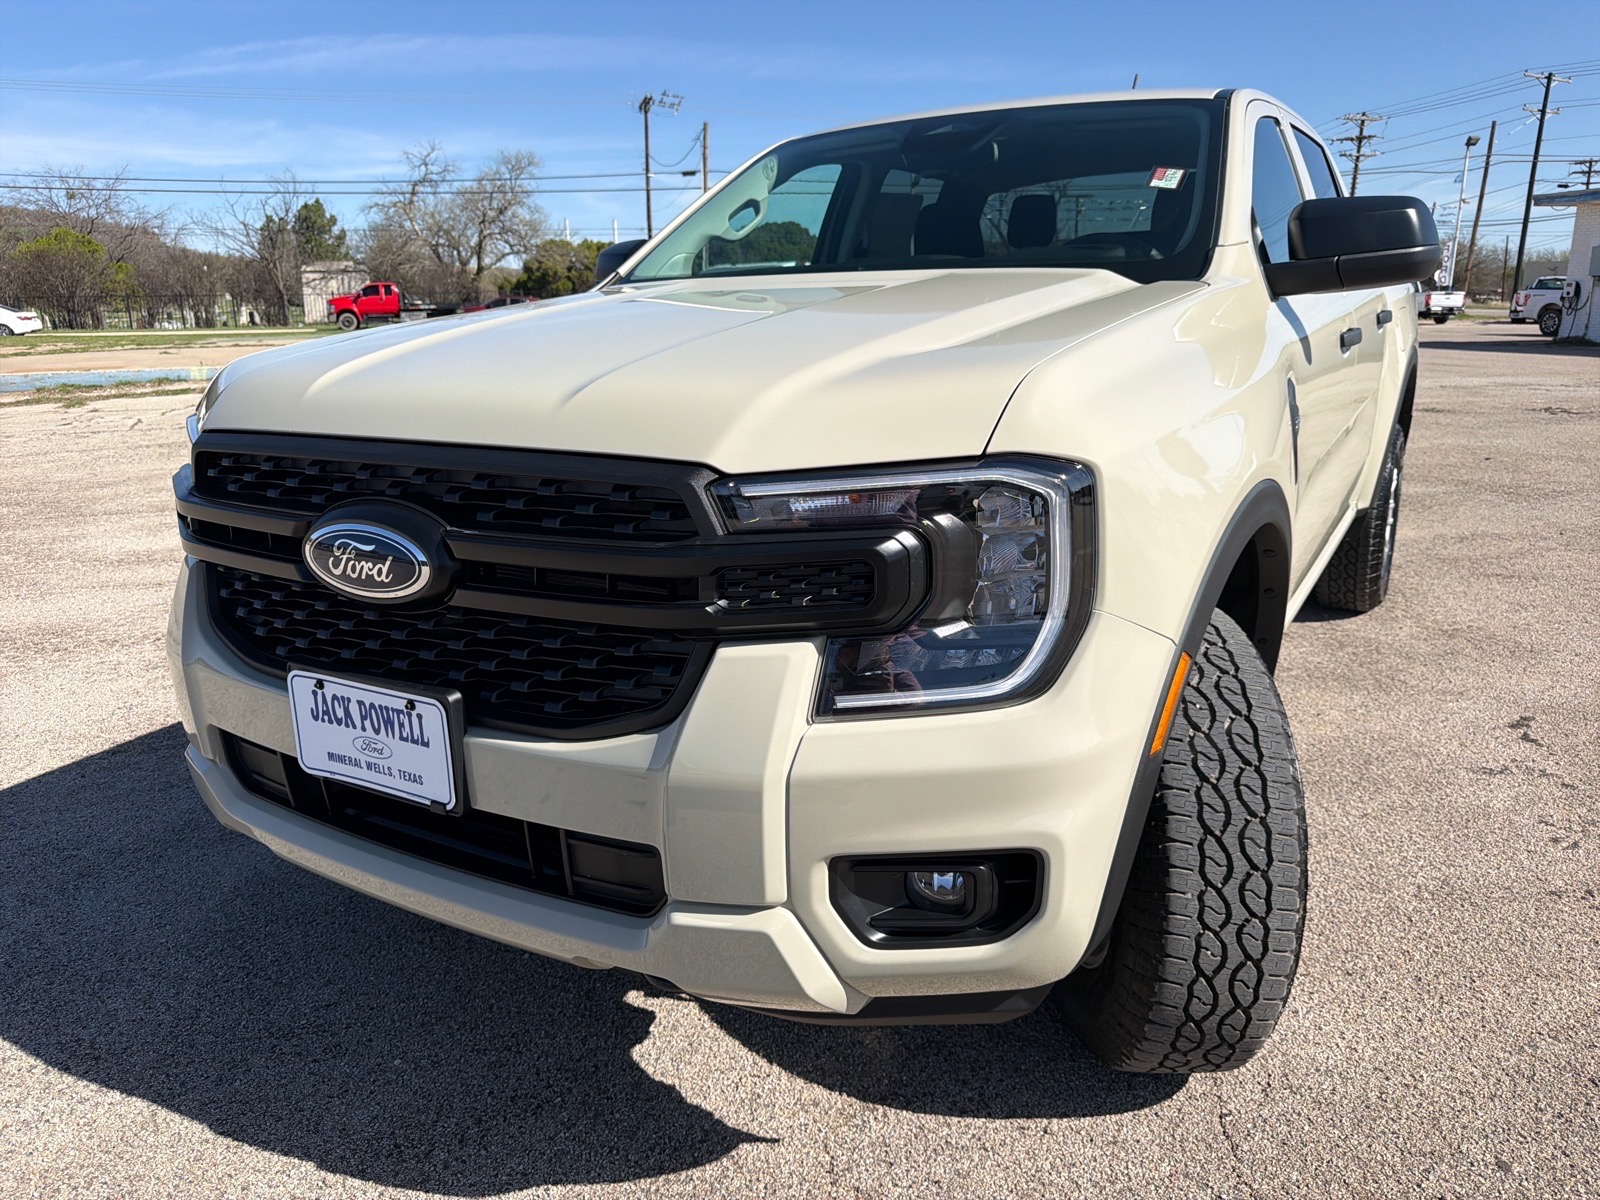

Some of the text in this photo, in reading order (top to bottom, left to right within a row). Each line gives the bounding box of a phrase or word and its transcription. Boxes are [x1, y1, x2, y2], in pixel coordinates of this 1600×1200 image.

[328, 538, 394, 583] Ford
[310, 689, 430, 749] JACK POWELL
[360, 737, 385, 756] Ford
[327, 751, 424, 786] MINERAL WELLS, TEXAS
